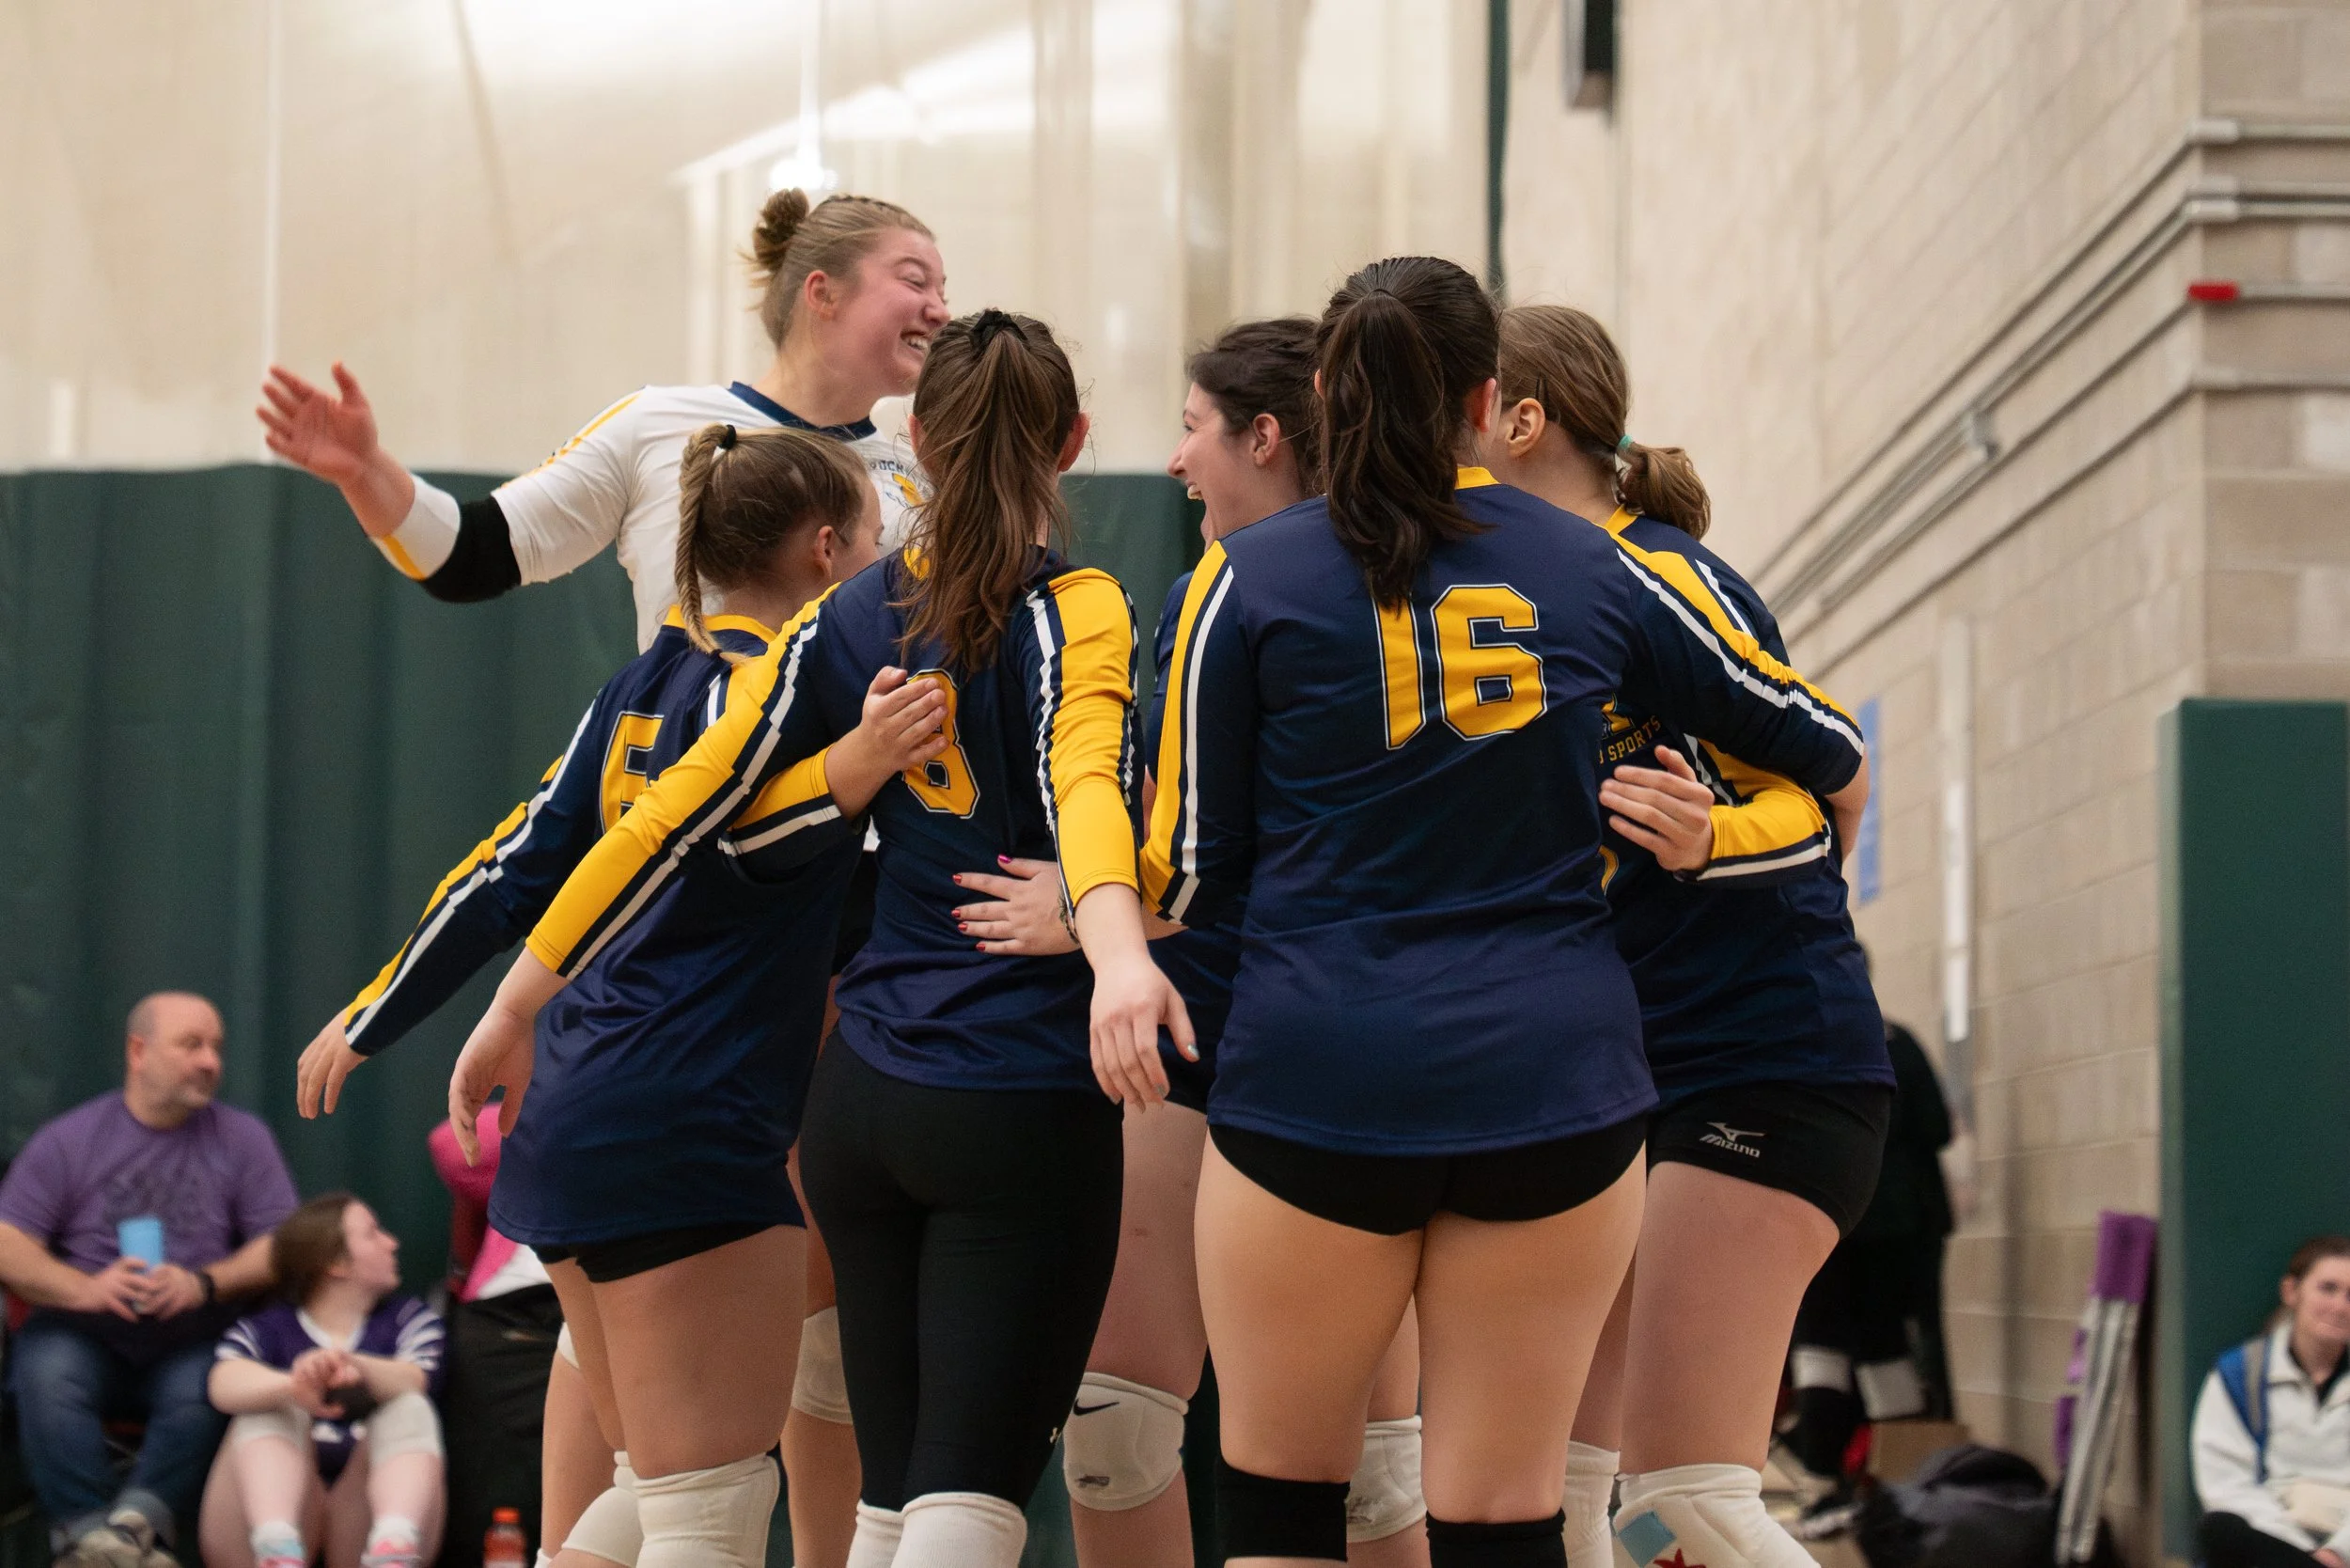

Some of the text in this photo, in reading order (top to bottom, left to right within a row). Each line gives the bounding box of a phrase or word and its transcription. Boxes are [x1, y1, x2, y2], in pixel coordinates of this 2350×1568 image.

[1371, 583, 1548, 750] 16
[1607, 714, 1661, 761] SPORTS
[1700, 1134, 1761, 1158] MIZUNO
